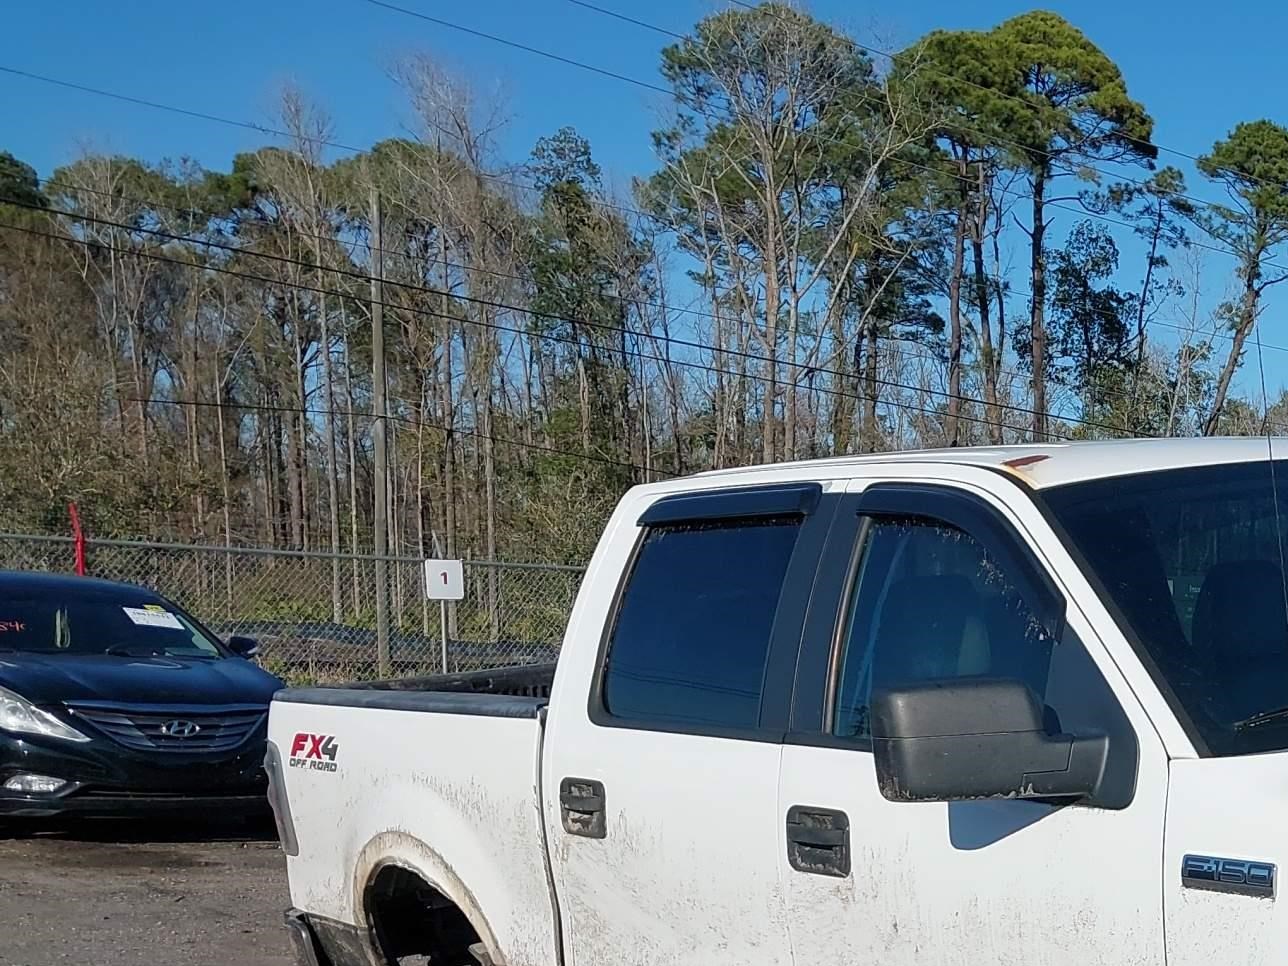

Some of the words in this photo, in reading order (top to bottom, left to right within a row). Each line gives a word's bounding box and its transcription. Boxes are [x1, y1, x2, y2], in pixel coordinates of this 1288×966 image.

[440, 571, 448, 585] 1
[290, 733, 339, 762] FX4
[289, 758, 307, 768] OFF
[309, 760, 338, 772] ROAD
